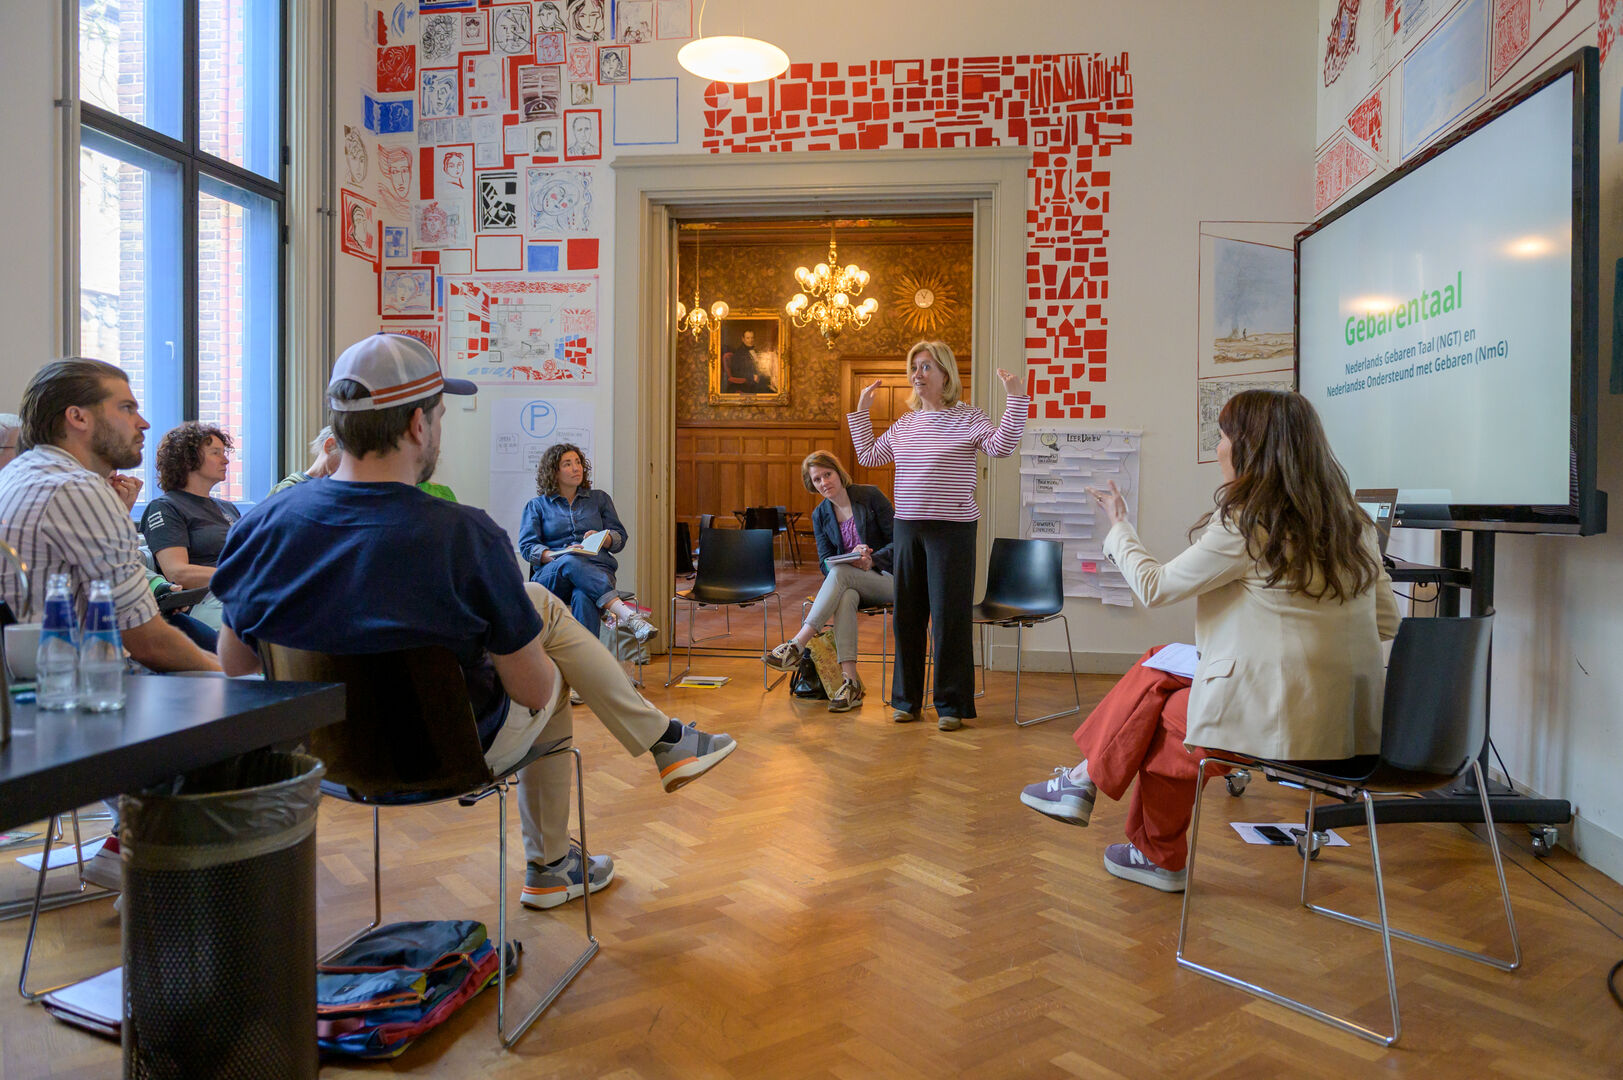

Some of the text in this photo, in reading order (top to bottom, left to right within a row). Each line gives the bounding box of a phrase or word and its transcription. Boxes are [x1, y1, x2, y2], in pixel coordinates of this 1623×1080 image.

[1345, 271, 1462, 346] Gebarentaal
[1327, 339, 1509, 397] Nederlandse Ondersteund met Gebaren (NmG)
[1346, 328, 1476, 374] Nederlands Gebaren Taal (NGT) en
[530, 405, 550, 431] P
